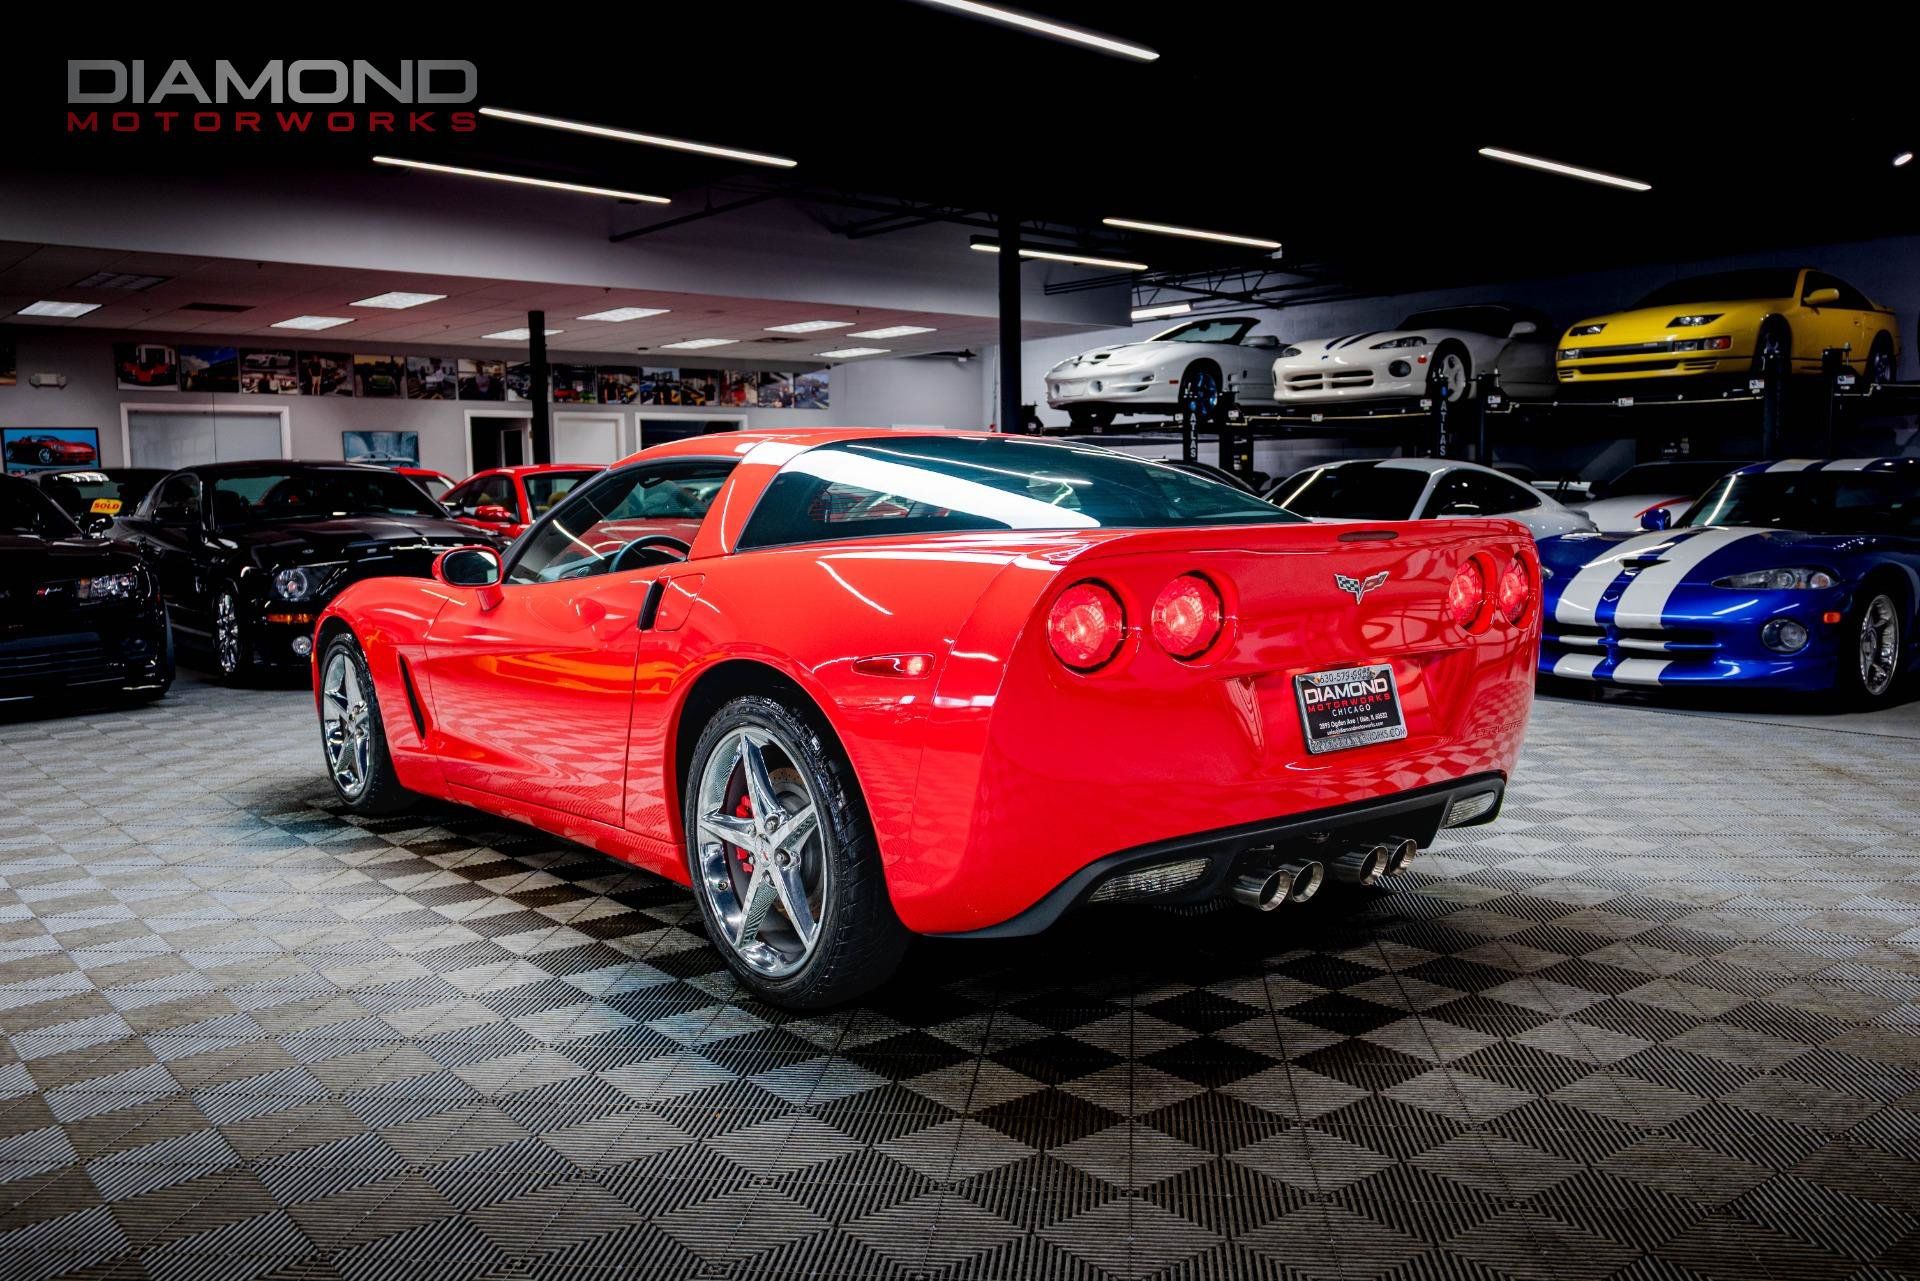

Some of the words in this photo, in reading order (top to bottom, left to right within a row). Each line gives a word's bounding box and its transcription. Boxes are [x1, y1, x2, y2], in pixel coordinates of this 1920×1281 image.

[1189, 412, 1197, 458] ATLAS
[1440, 399, 1448, 457] ATLAS
[1303, 677, 1389, 705] DIAMOND
[1307, 693, 1391, 713] MOTORWORKS
[1332, 703, 1371, 717] CHICAGO
